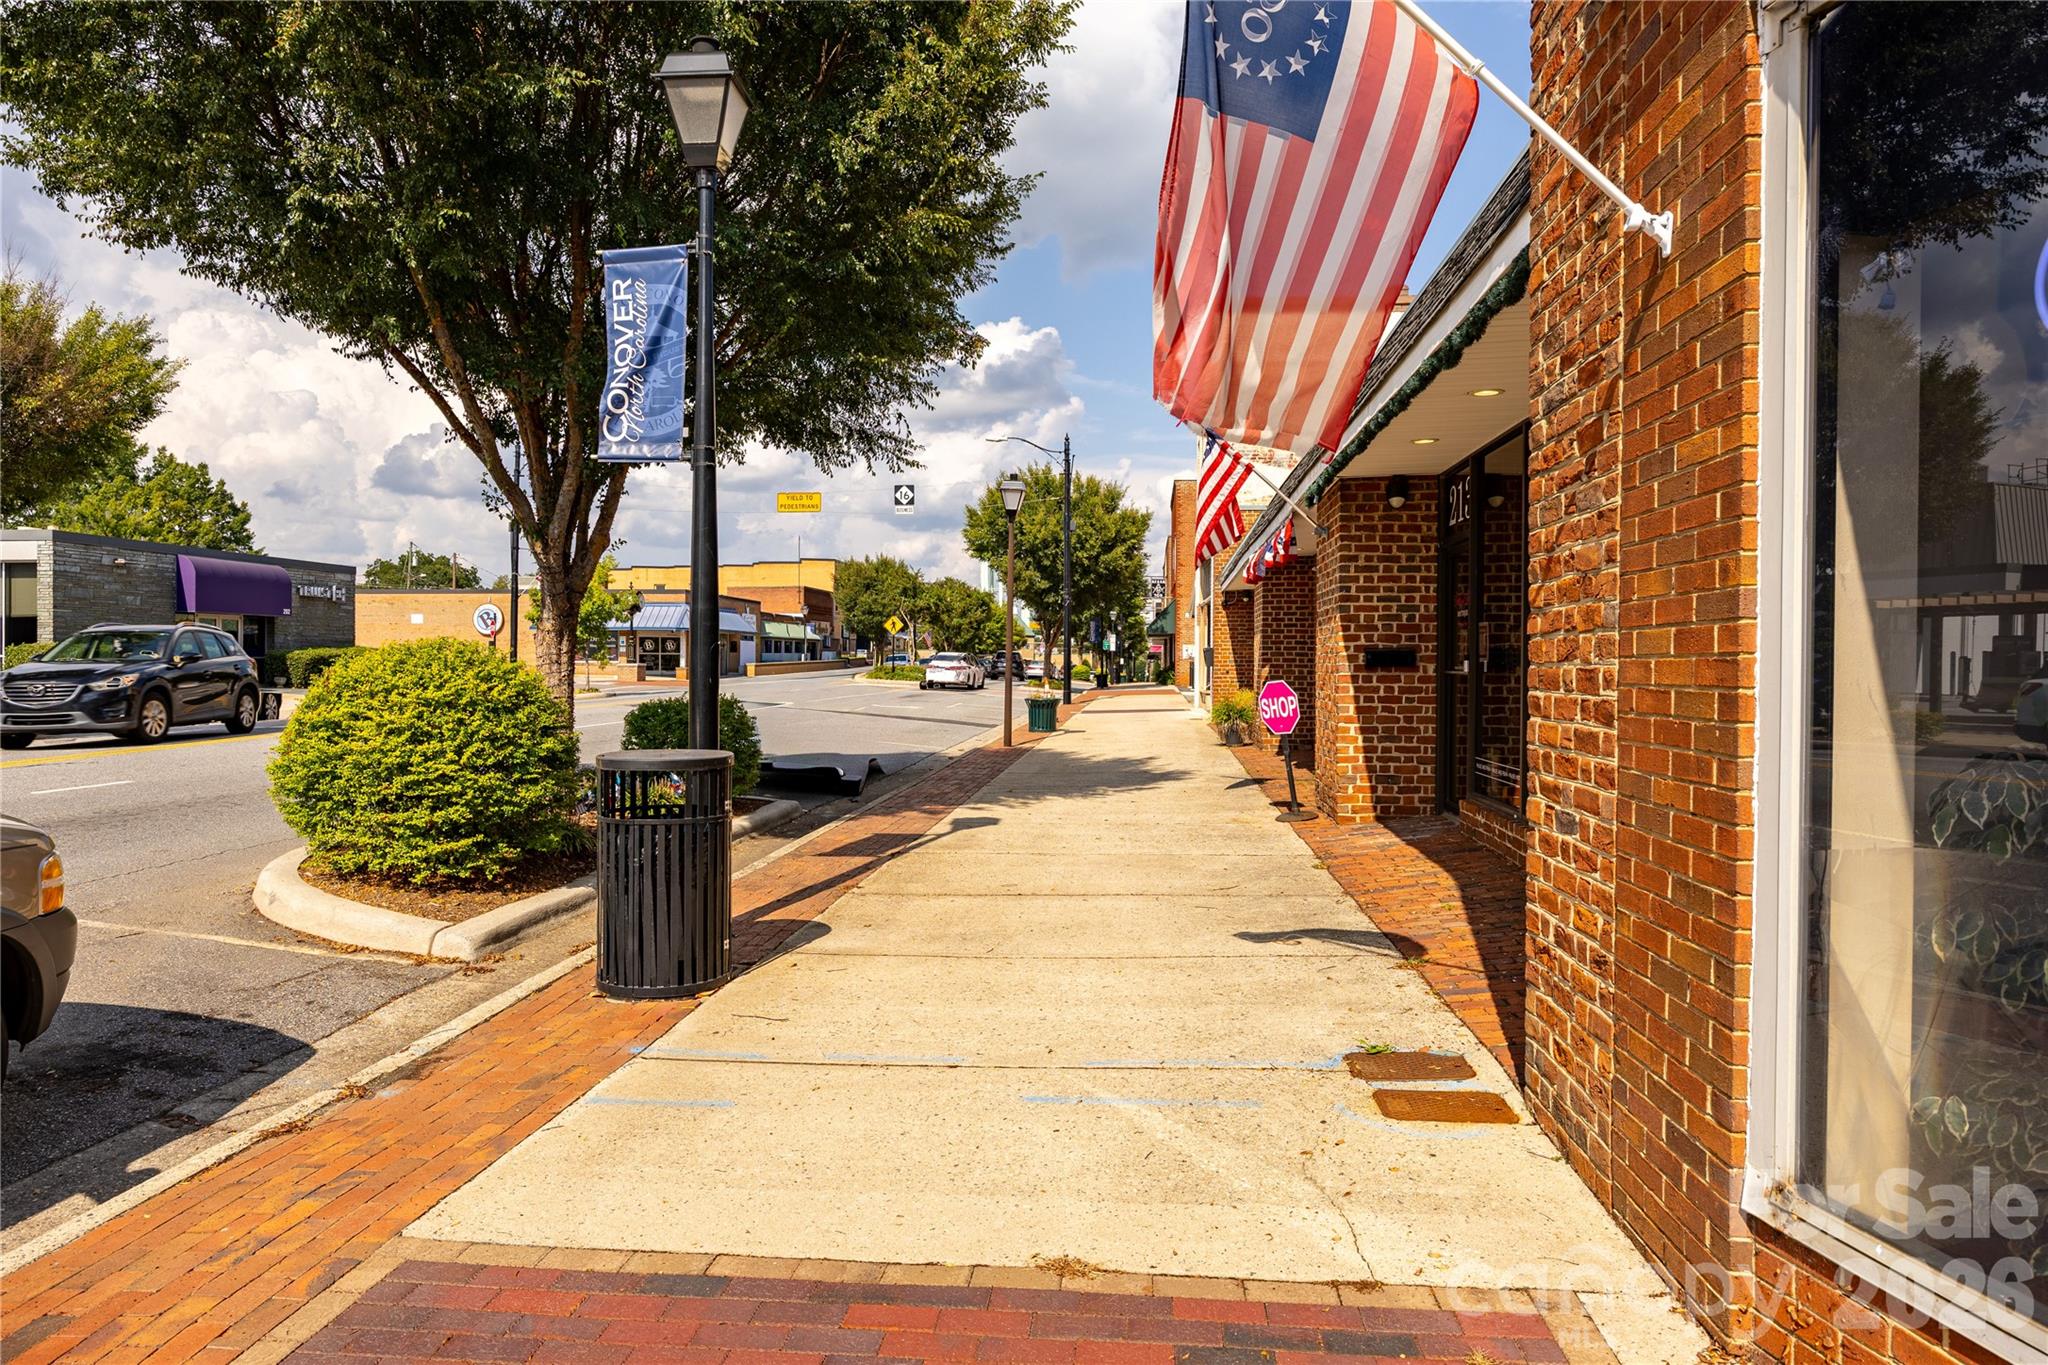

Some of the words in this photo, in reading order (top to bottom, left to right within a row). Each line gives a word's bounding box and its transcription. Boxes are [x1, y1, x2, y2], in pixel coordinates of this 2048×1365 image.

[627, 278, 648, 369] Carolina
[602, 277, 634, 442] CONOVER
[624, 373, 645, 442] North
[899, 490, 910, 501] 16
[1261, 696, 1296, 719] SHOP
